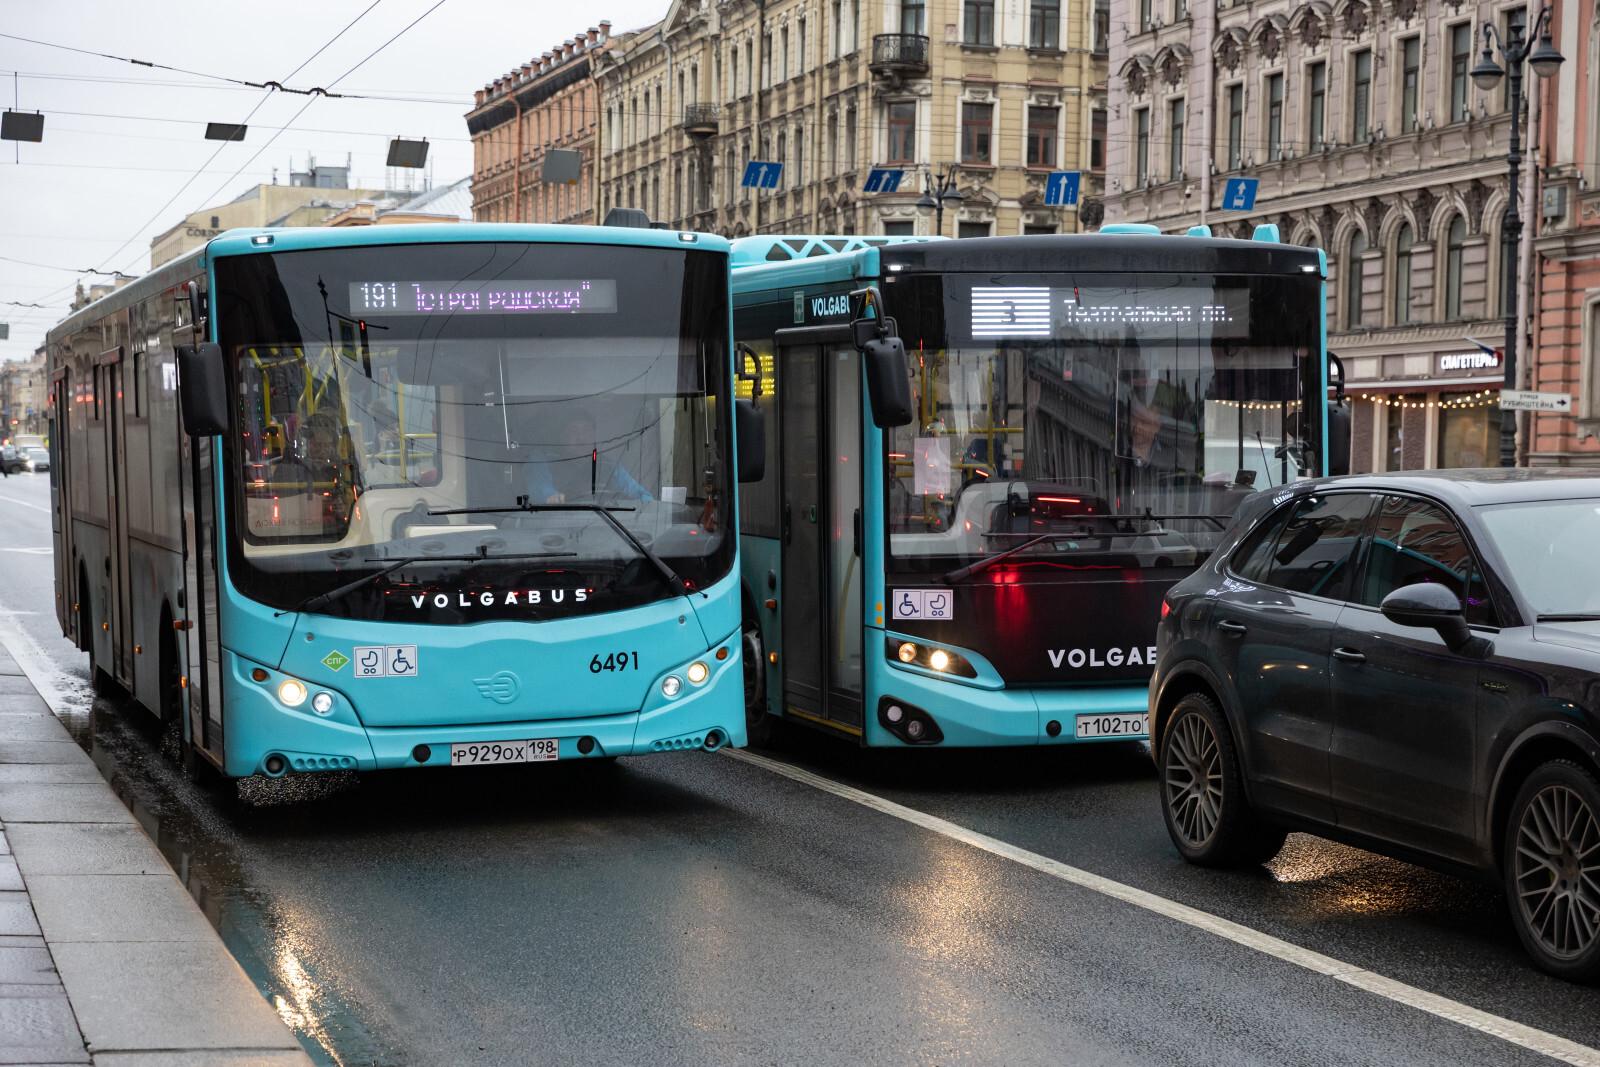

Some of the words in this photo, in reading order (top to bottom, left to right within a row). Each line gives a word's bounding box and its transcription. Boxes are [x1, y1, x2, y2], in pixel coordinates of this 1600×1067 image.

[360, 282, 397, 308] 191
[1001, 300, 1017, 324] 3
[1502, 400, 1554, 408] РУБИНШТЕЙНА
[411, 588, 588, 609] VOLGABUS
[589, 651, 639, 674] 6491
[1082, 717, 1142, 735] Т102ТО
[457, 744, 524, 763] Р929ОХ
[528, 740, 554, 755] 198
